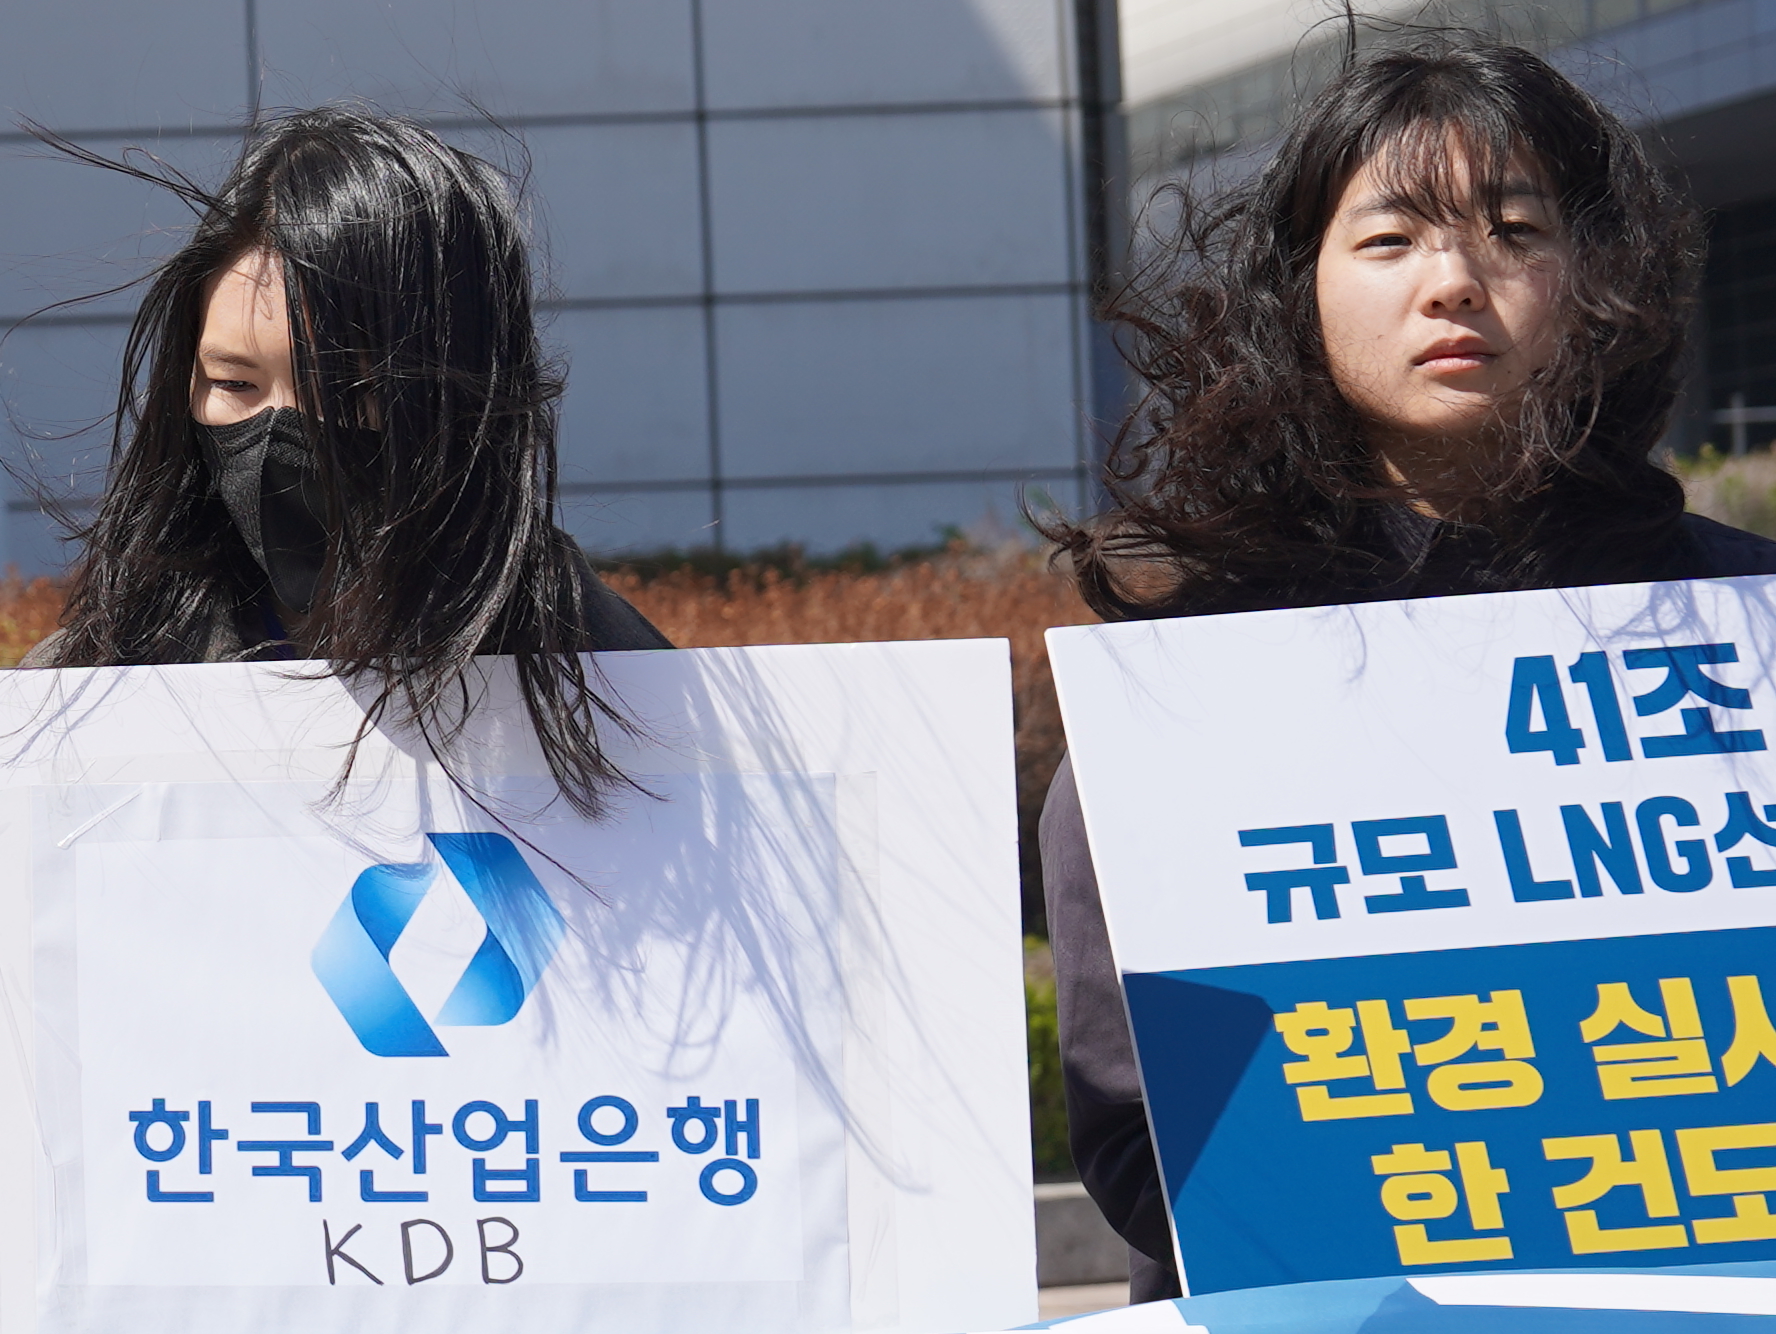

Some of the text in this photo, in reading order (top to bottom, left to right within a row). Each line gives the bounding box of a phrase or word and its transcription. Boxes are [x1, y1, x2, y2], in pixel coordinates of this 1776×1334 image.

[1505, 643, 1767, 766] 41조
[1238, 815, 1471, 924] 규모
[1274, 990, 1544, 1121] 환경
[128, 1095, 762, 1207] 한국산업은행
[1371, 1142, 1514, 1266] 한
[323, 1216, 524, 1286] KDB
